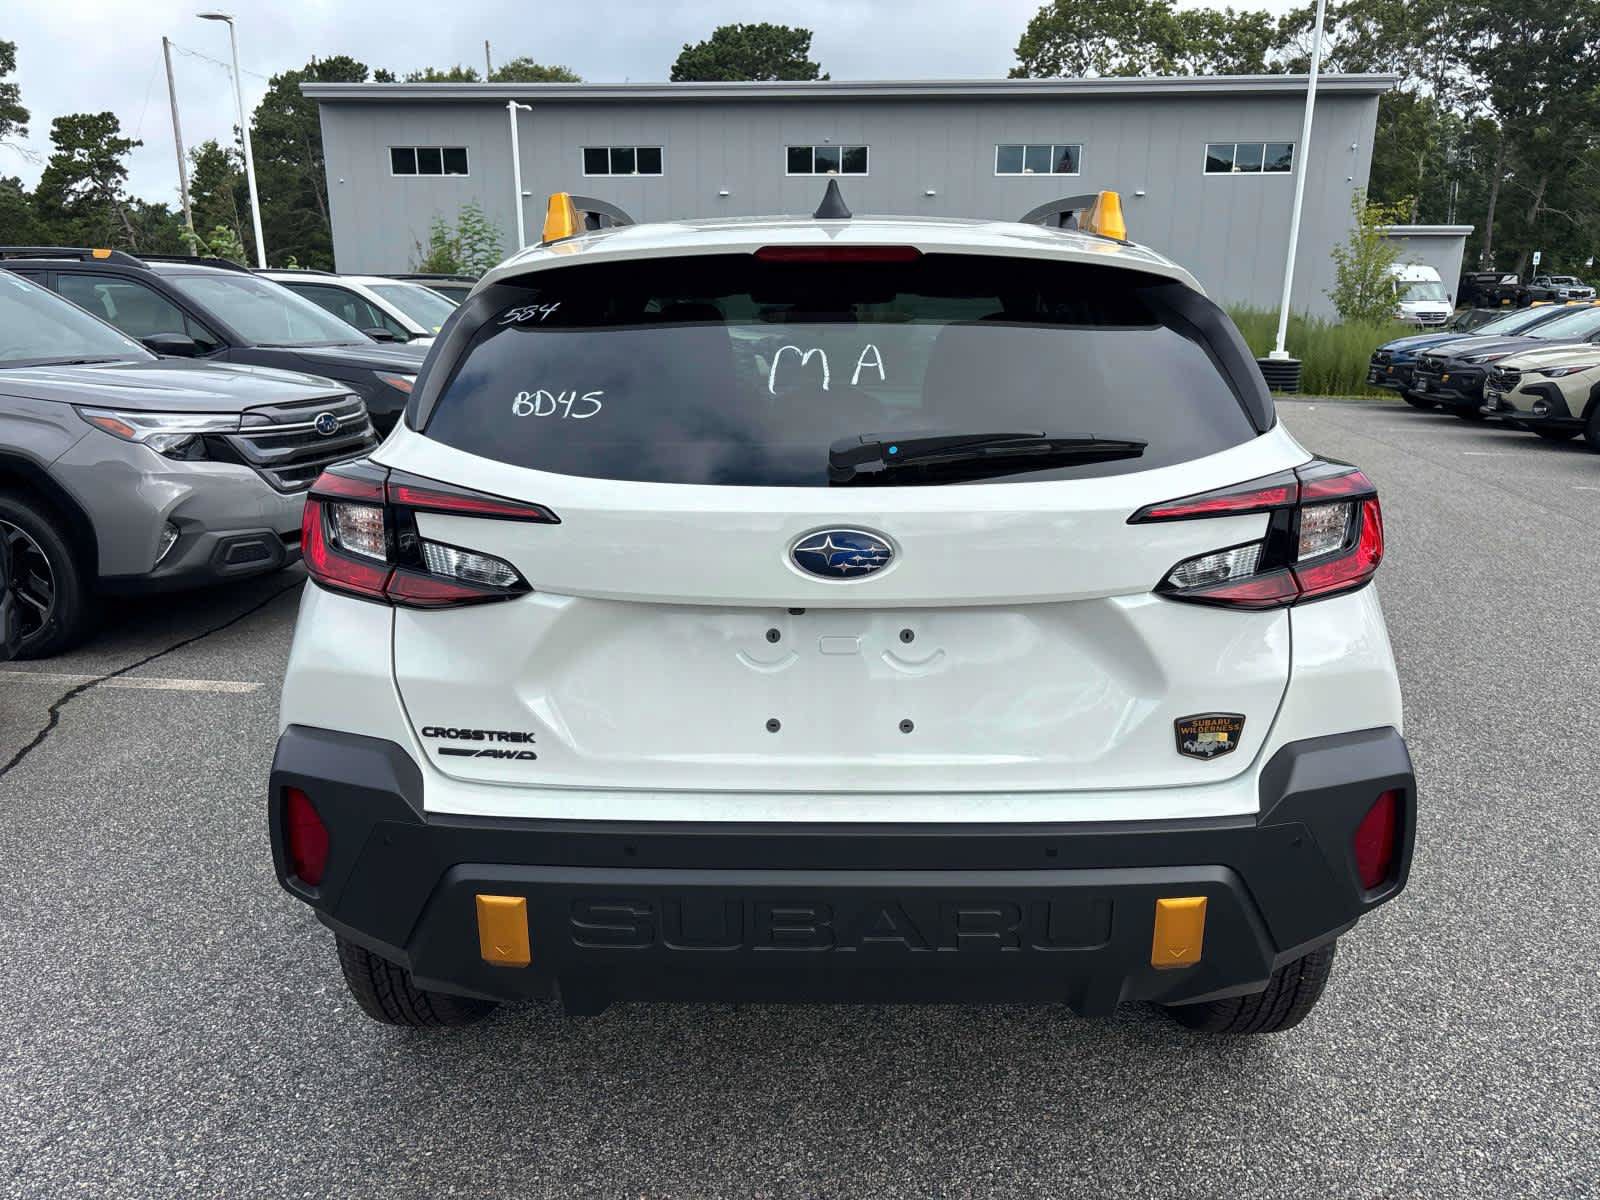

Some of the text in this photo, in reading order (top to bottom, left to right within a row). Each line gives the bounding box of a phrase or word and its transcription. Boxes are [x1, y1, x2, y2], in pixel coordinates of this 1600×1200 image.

[498, 302, 560, 325] 584
[1181, 723, 1240, 734] WILDERNESS
[1192, 718, 1230, 727] SUBARU
[421, 726, 536, 743] CROSSTREK
[474, 749, 538, 760] AWD
[568, 897, 1115, 953] SUBARU
